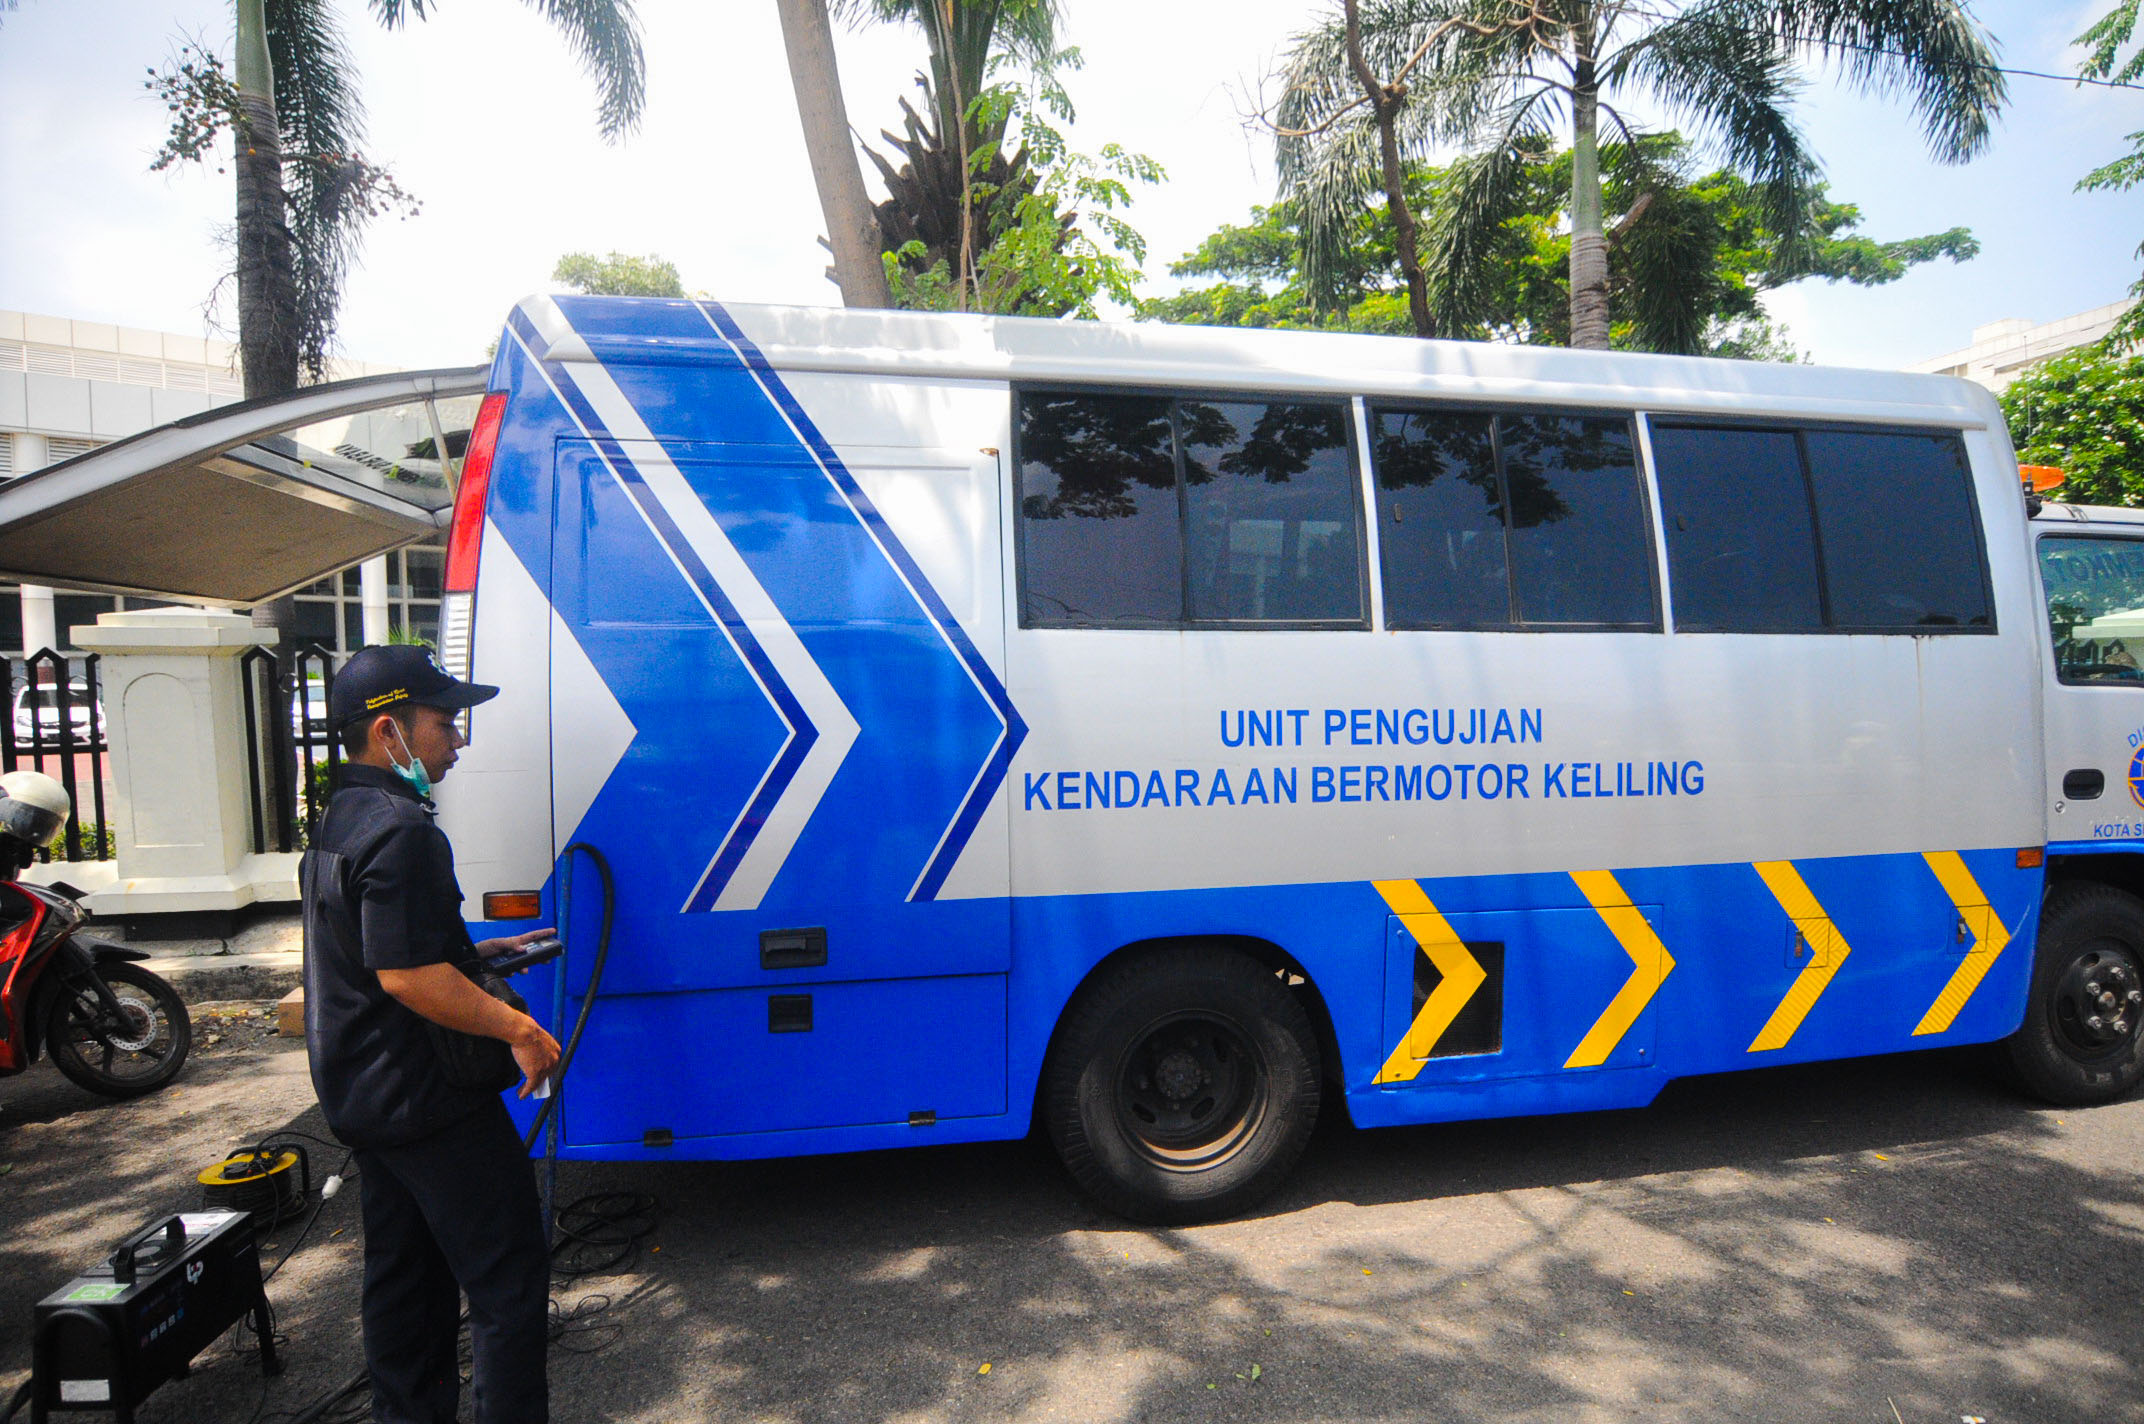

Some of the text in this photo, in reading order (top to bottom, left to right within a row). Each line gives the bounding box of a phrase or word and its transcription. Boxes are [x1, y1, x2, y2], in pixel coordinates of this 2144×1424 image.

[1221, 709, 1542, 747] UNIT PENGUJIAN
[2127, 727, 2144, 748] DI
[1025, 761, 1704, 810] KENDARAAN BERMOTOR KELILING
[2094, 823, 2144, 837] KOTA S
